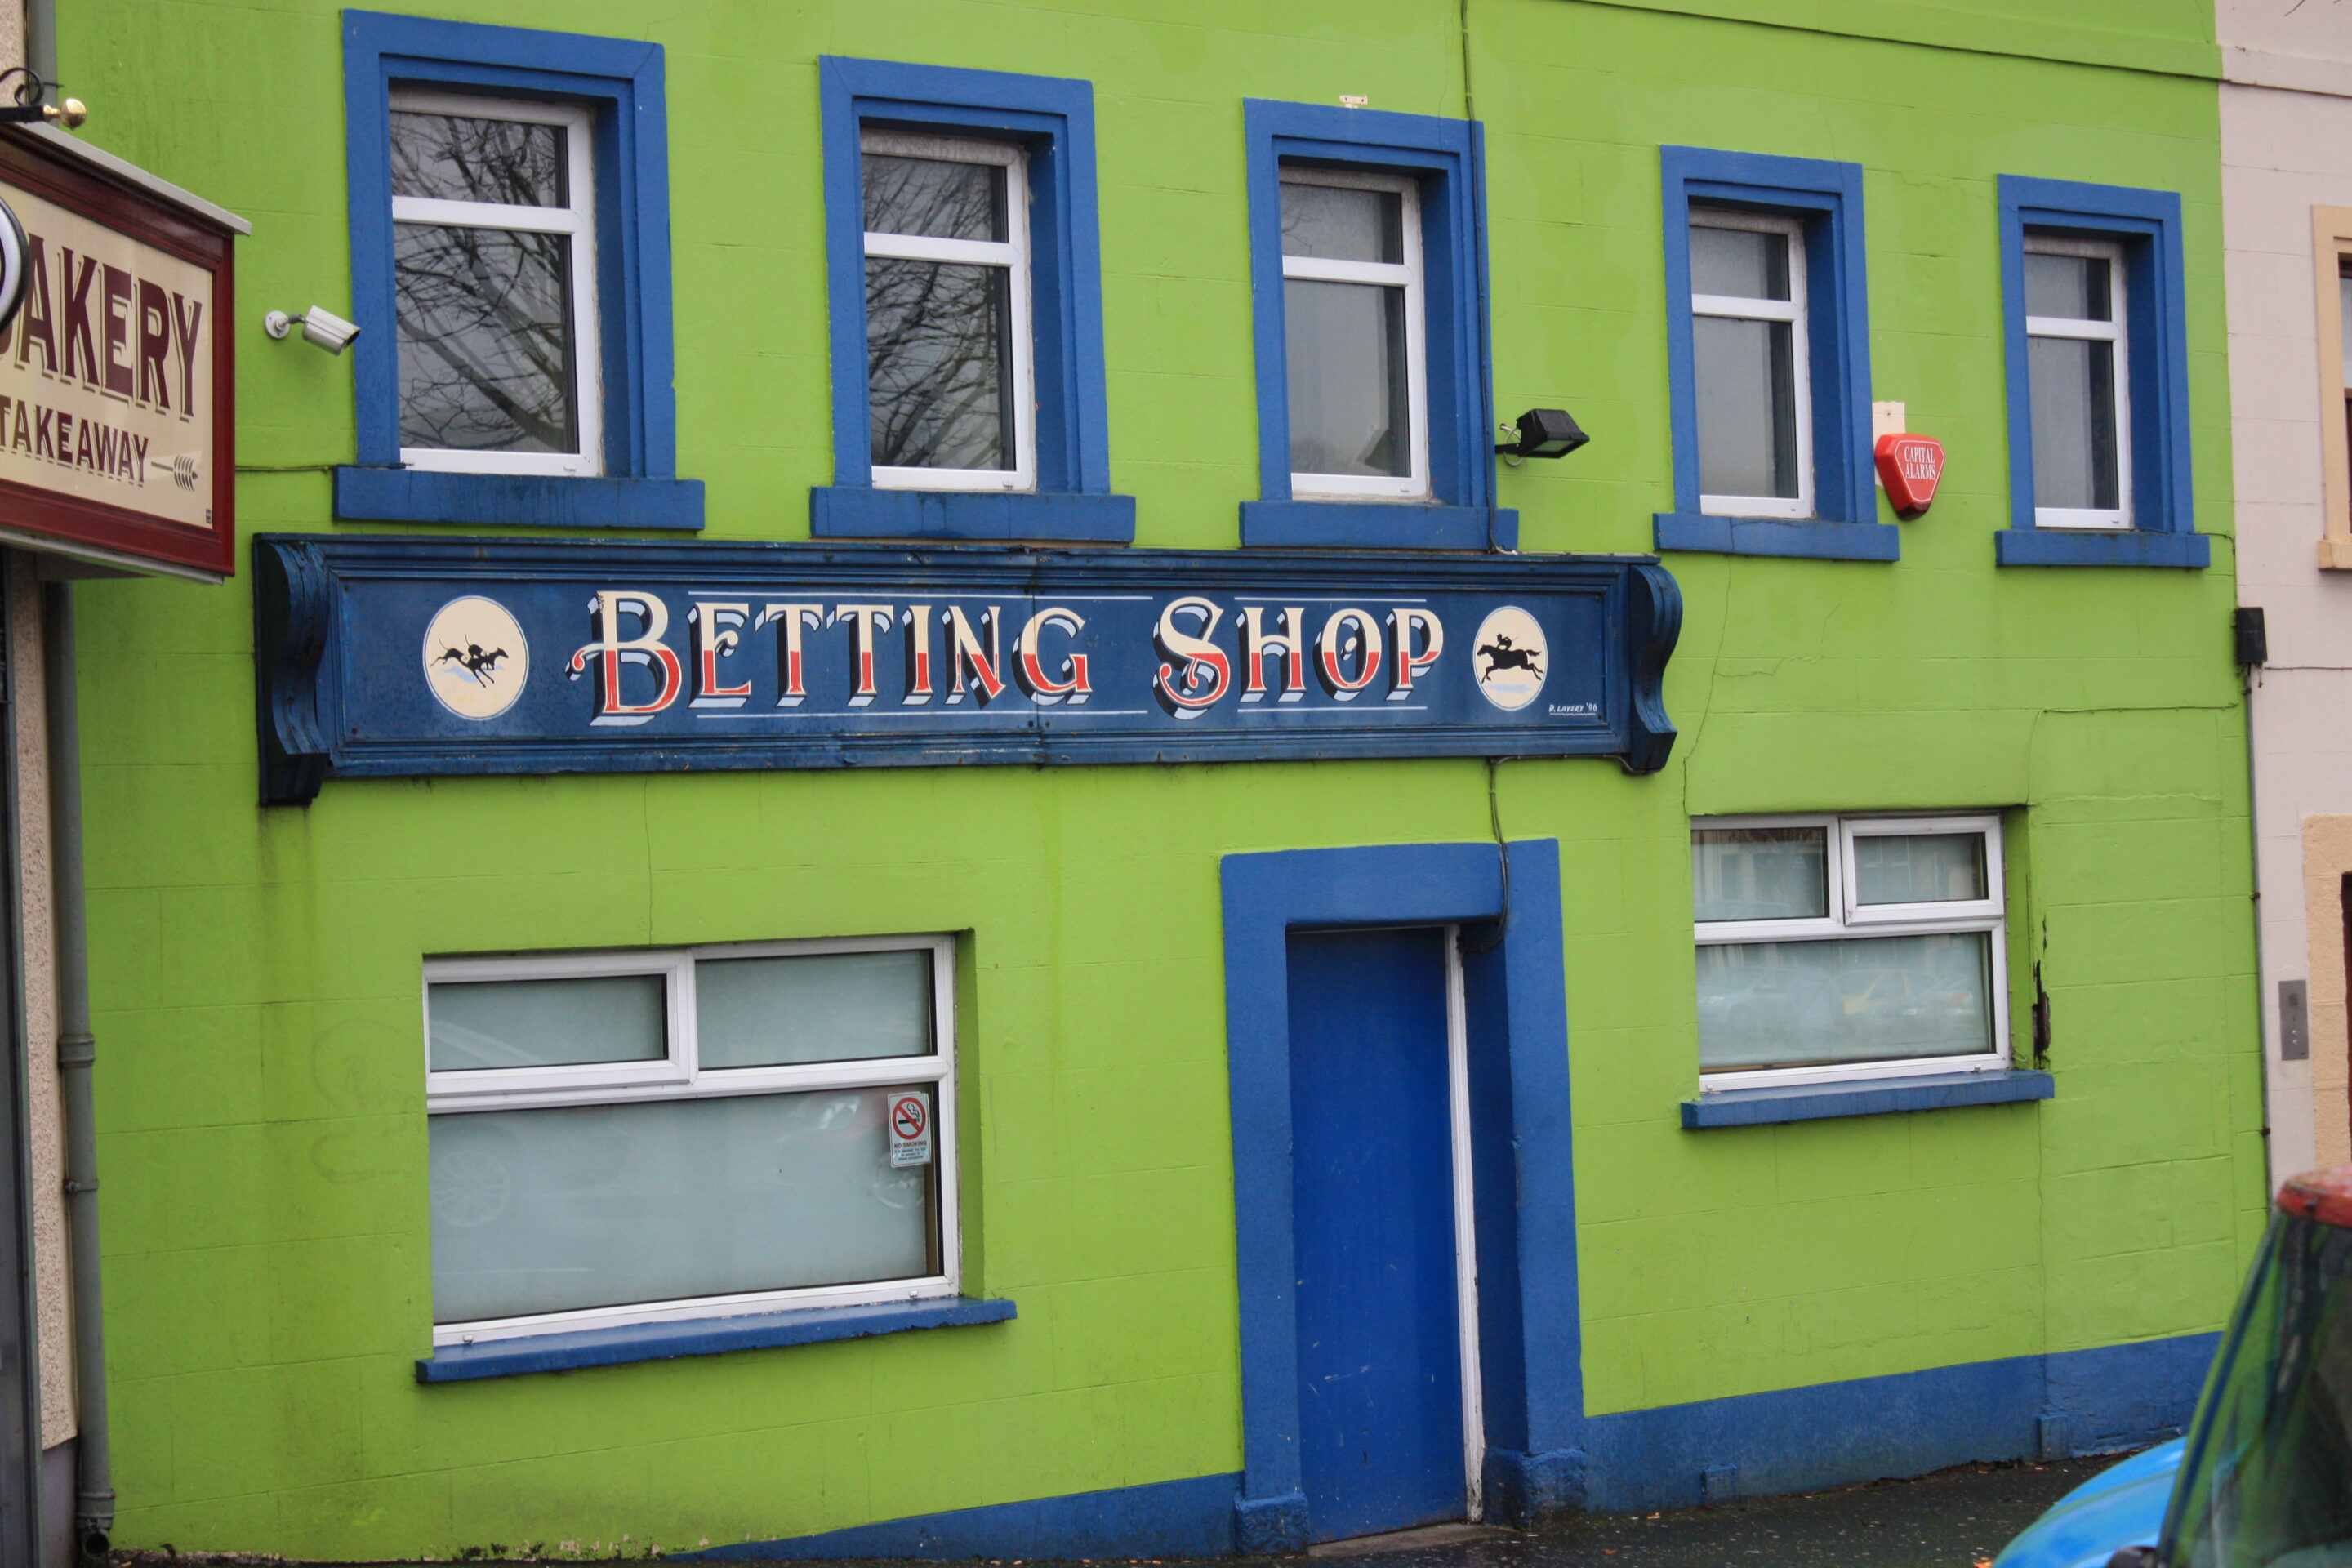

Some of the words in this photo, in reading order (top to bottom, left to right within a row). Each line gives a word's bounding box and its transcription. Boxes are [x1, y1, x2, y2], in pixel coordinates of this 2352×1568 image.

[0, 232, 203, 421] AKERY
[0, 395, 149, 487] TAKEAWAY
[1904, 446, 1936, 464] CAPITAL
[1905, 464, 1936, 480] ALARMS
[565, 590, 1094, 726] BETTING
[1152, 596, 1444, 720] SHOP
[1586, 702, 1597, 712] '96
